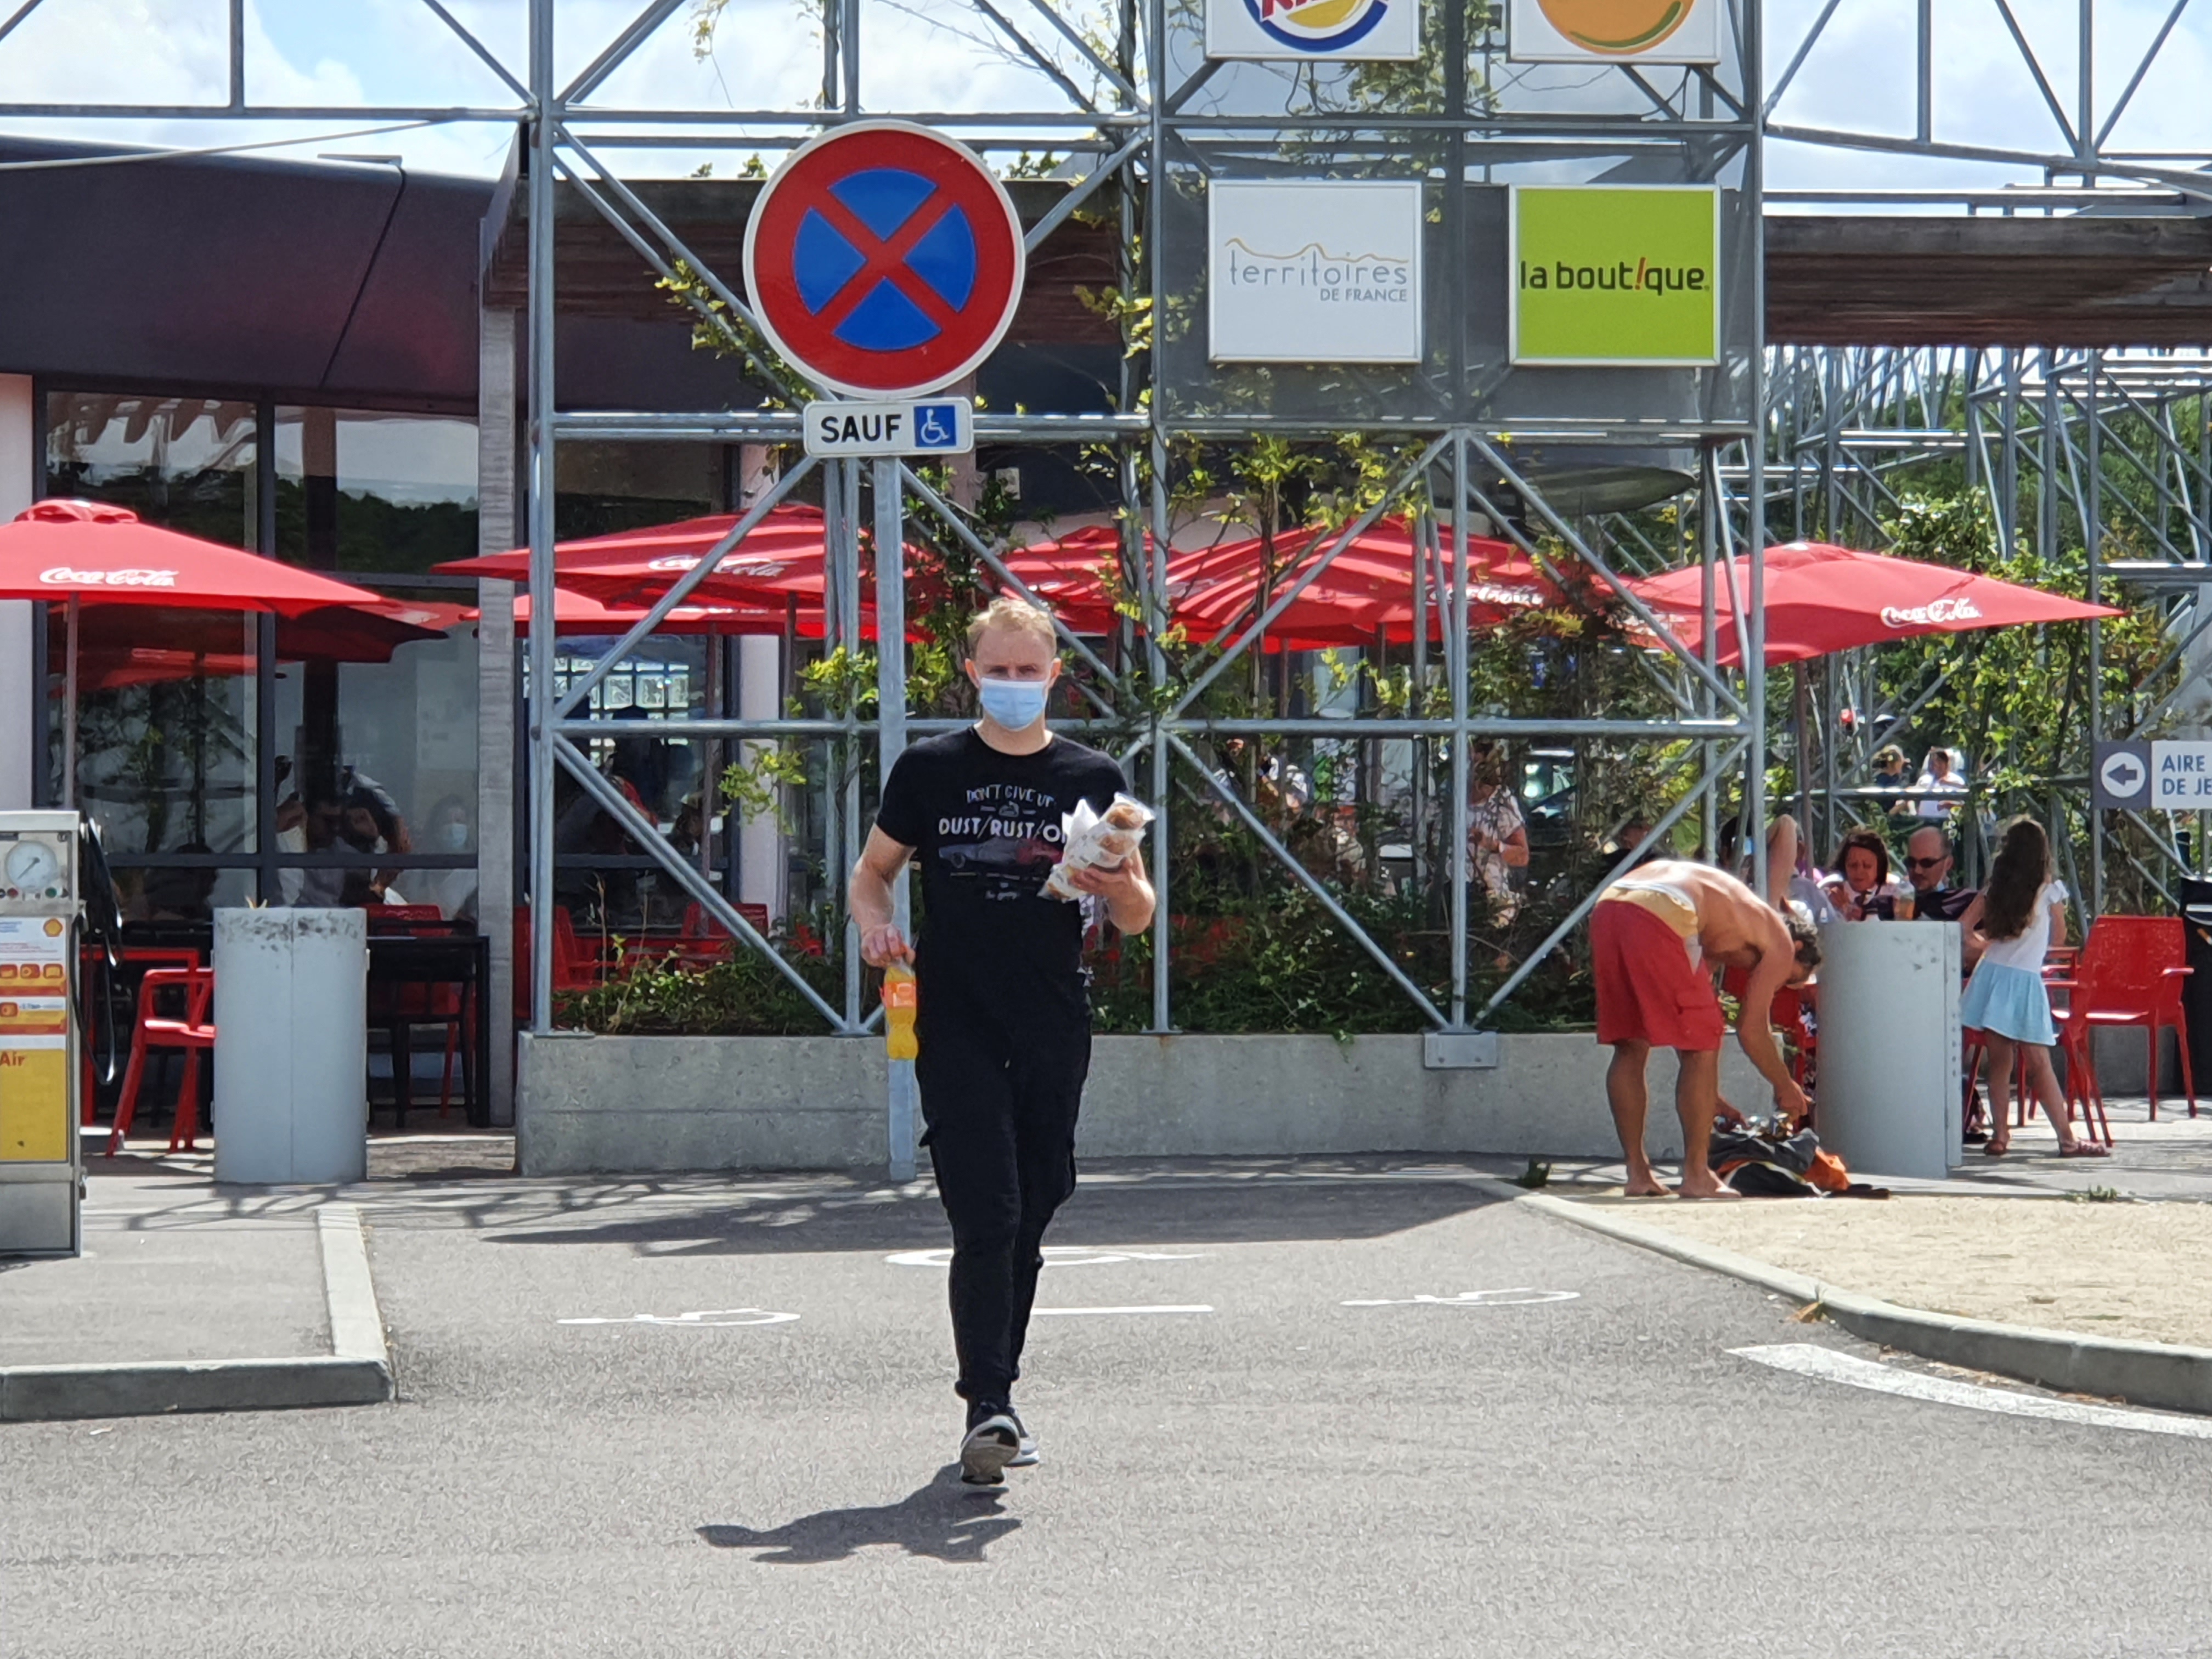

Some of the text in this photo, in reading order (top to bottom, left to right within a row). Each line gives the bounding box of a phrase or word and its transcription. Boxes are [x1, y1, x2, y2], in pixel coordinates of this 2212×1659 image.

[1231, 250, 1407, 286] territoires
[1521, 261, 1548, 290] la
[1320, 289, 1407, 302] DE FRANCE
[821, 414, 901, 443] SAUF
[2162, 754, 2205, 772] AIRE
[1005, 786, 1036, 802] GIVE
[2162, 778, 2186, 795] DE
[0, 1051, 26, 1066] Air
